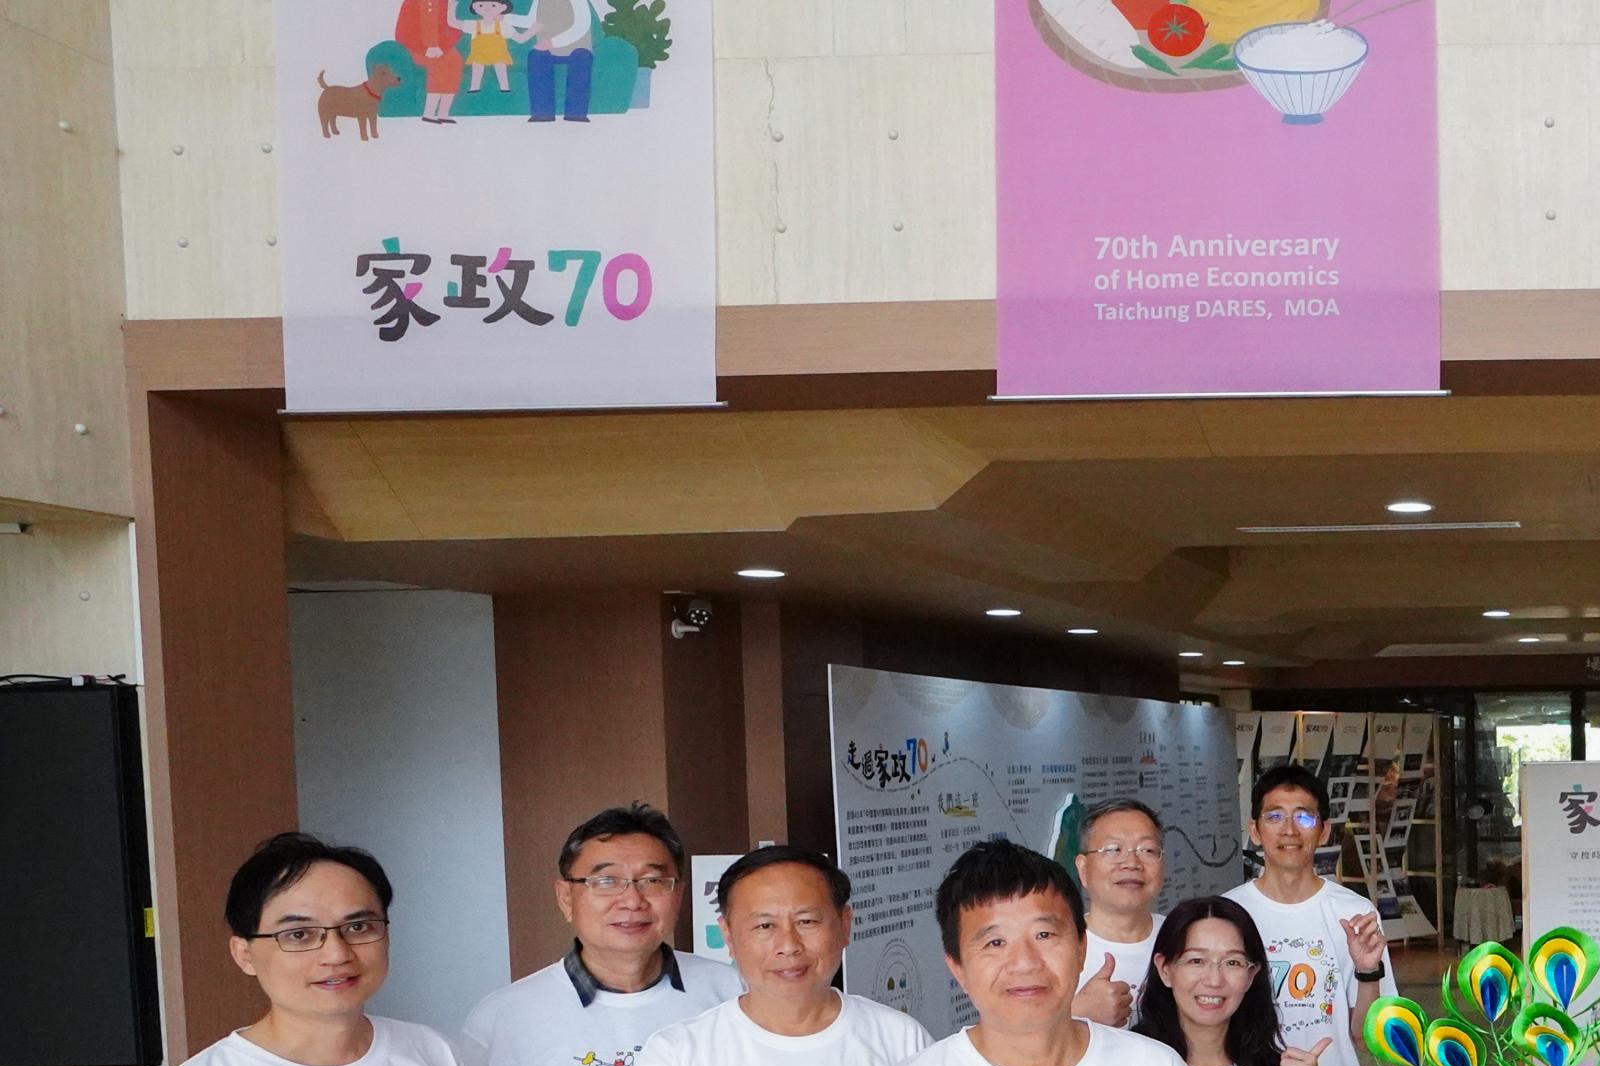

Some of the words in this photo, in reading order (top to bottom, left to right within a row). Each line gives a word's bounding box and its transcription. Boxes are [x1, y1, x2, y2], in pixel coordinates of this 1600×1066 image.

[1094, 235, 1158, 260] 70th
[1168, 234, 1340, 260] Anniversary
[356, 237, 652, 342] 家政70
[1094, 269, 1121, 290] of
[1127, 269, 1200, 290] Home
[1207, 265, 1340, 287] Economics
[1094, 302, 1190, 323] Taichung
[1196, 300, 1273, 320] DARES,
[1284, 298, 1340, 317] MOA
